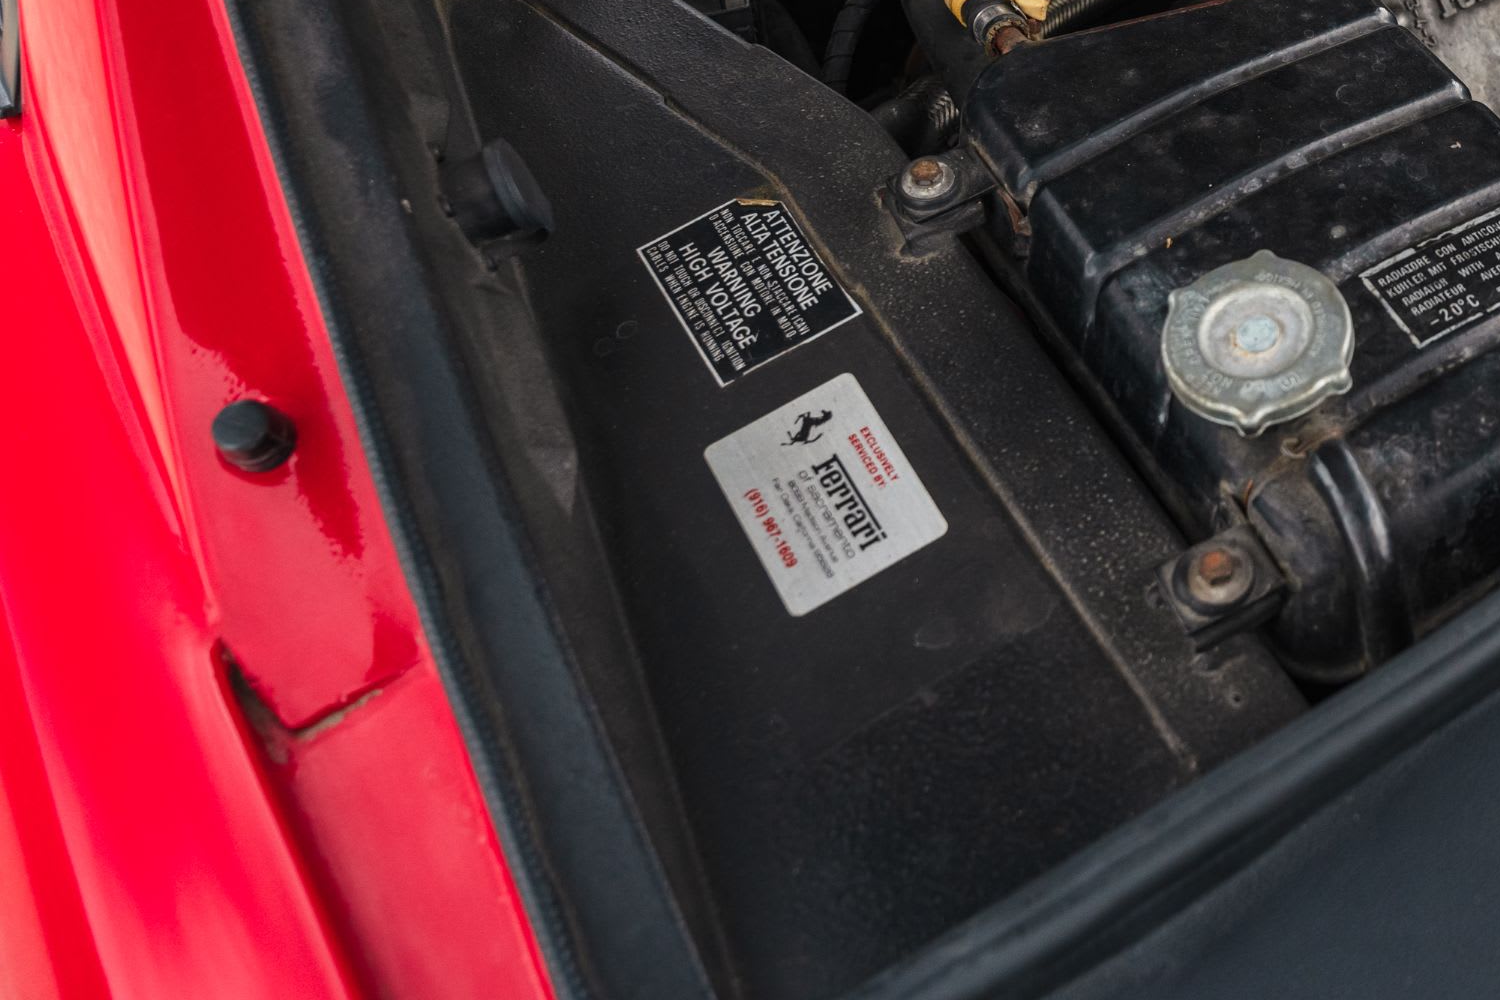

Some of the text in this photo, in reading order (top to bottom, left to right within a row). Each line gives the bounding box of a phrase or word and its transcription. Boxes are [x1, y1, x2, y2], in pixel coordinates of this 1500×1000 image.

[645, 246, 669, 273] CABLES
[663, 274, 682, 294] WHEN
[675, 293, 698, 320] ENGINE
[692, 320, 705, 330] IS
[704, 246, 763, 318] WARNING
[719, 208, 735, 223] NON
[728, 223, 755, 254] TOCCARE
[755, 263, 772, 280] NON
[765, 278, 797, 316] STACCARE
[739, 211, 818, 310] ALTA TENSIONE
[739, 260, 755, 276] CON
[750, 277, 775, 305] MOTORE
[769, 305, 782, 316] IN
[761, 208, 833, 295] ATTENZIONE
[1376, 254, 1431, 286] RADIATORE
[1434, 242, 1457, 258] CON
[1400, 277, 1449, 306] RADIATOR
[1457, 259, 1485, 277] WITH
[1426, 261, 1448, 276] MIT
[657, 240, 746, 371] DO NOT TOUCH OR DISCONNECT IGNITION
[677, 242, 757, 350] HIGH VOLTAGE
[1408, 283, 1467, 316] RADIATEUR
[846, 432, 879, 475] SERVICED
[859, 425, 899, 482] EXCLUSIVELY
[743, 487, 798, 568] (916) 967-1609
[796, 467, 857, 560] of sacramento
[810, 453, 887, 551] Ferrari
